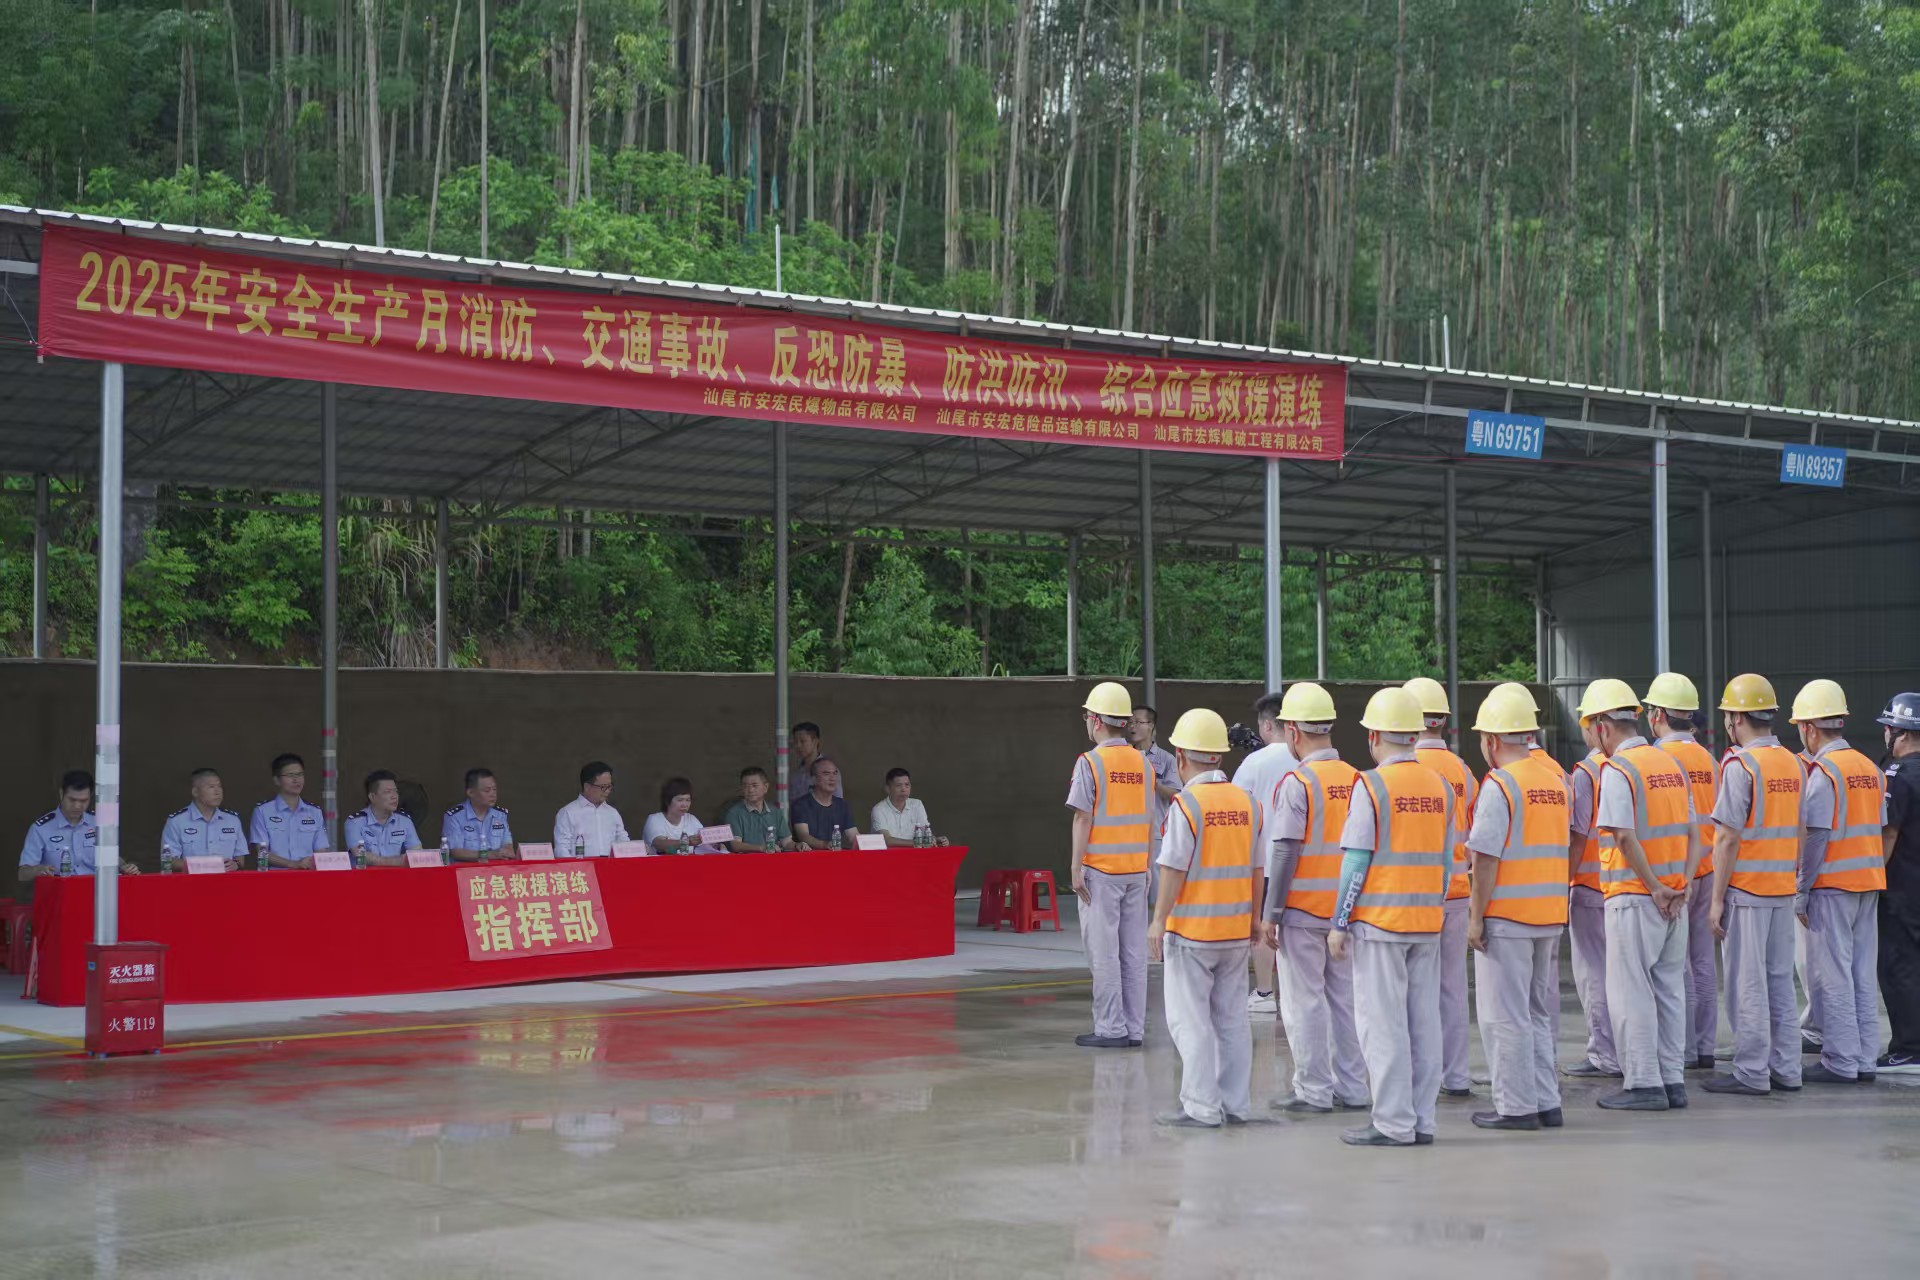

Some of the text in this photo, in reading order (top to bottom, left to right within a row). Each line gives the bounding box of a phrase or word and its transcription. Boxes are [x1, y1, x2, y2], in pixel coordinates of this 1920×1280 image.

[703, 387, 1323, 452] 汕尾市安宏民爆物品有限公司 汕尾市安宏危险品运输有限公司 汕尾市宏辉爆破工程有限公司
[1110, 771, 1144, 785] 安宏民爆
[1646, 773, 1685, 790] 安宏民爆
[1395, 796, 1444, 813] 安宏民爆
[1527, 789, 1566, 805] 安宏民爆
[1205, 811, 1250, 827] 安宏民爆
[470, 870, 590, 900] 应急救援演练
[472, 899, 599, 951] 指挥部
[109, 963, 155, 978] 灭火器箱
